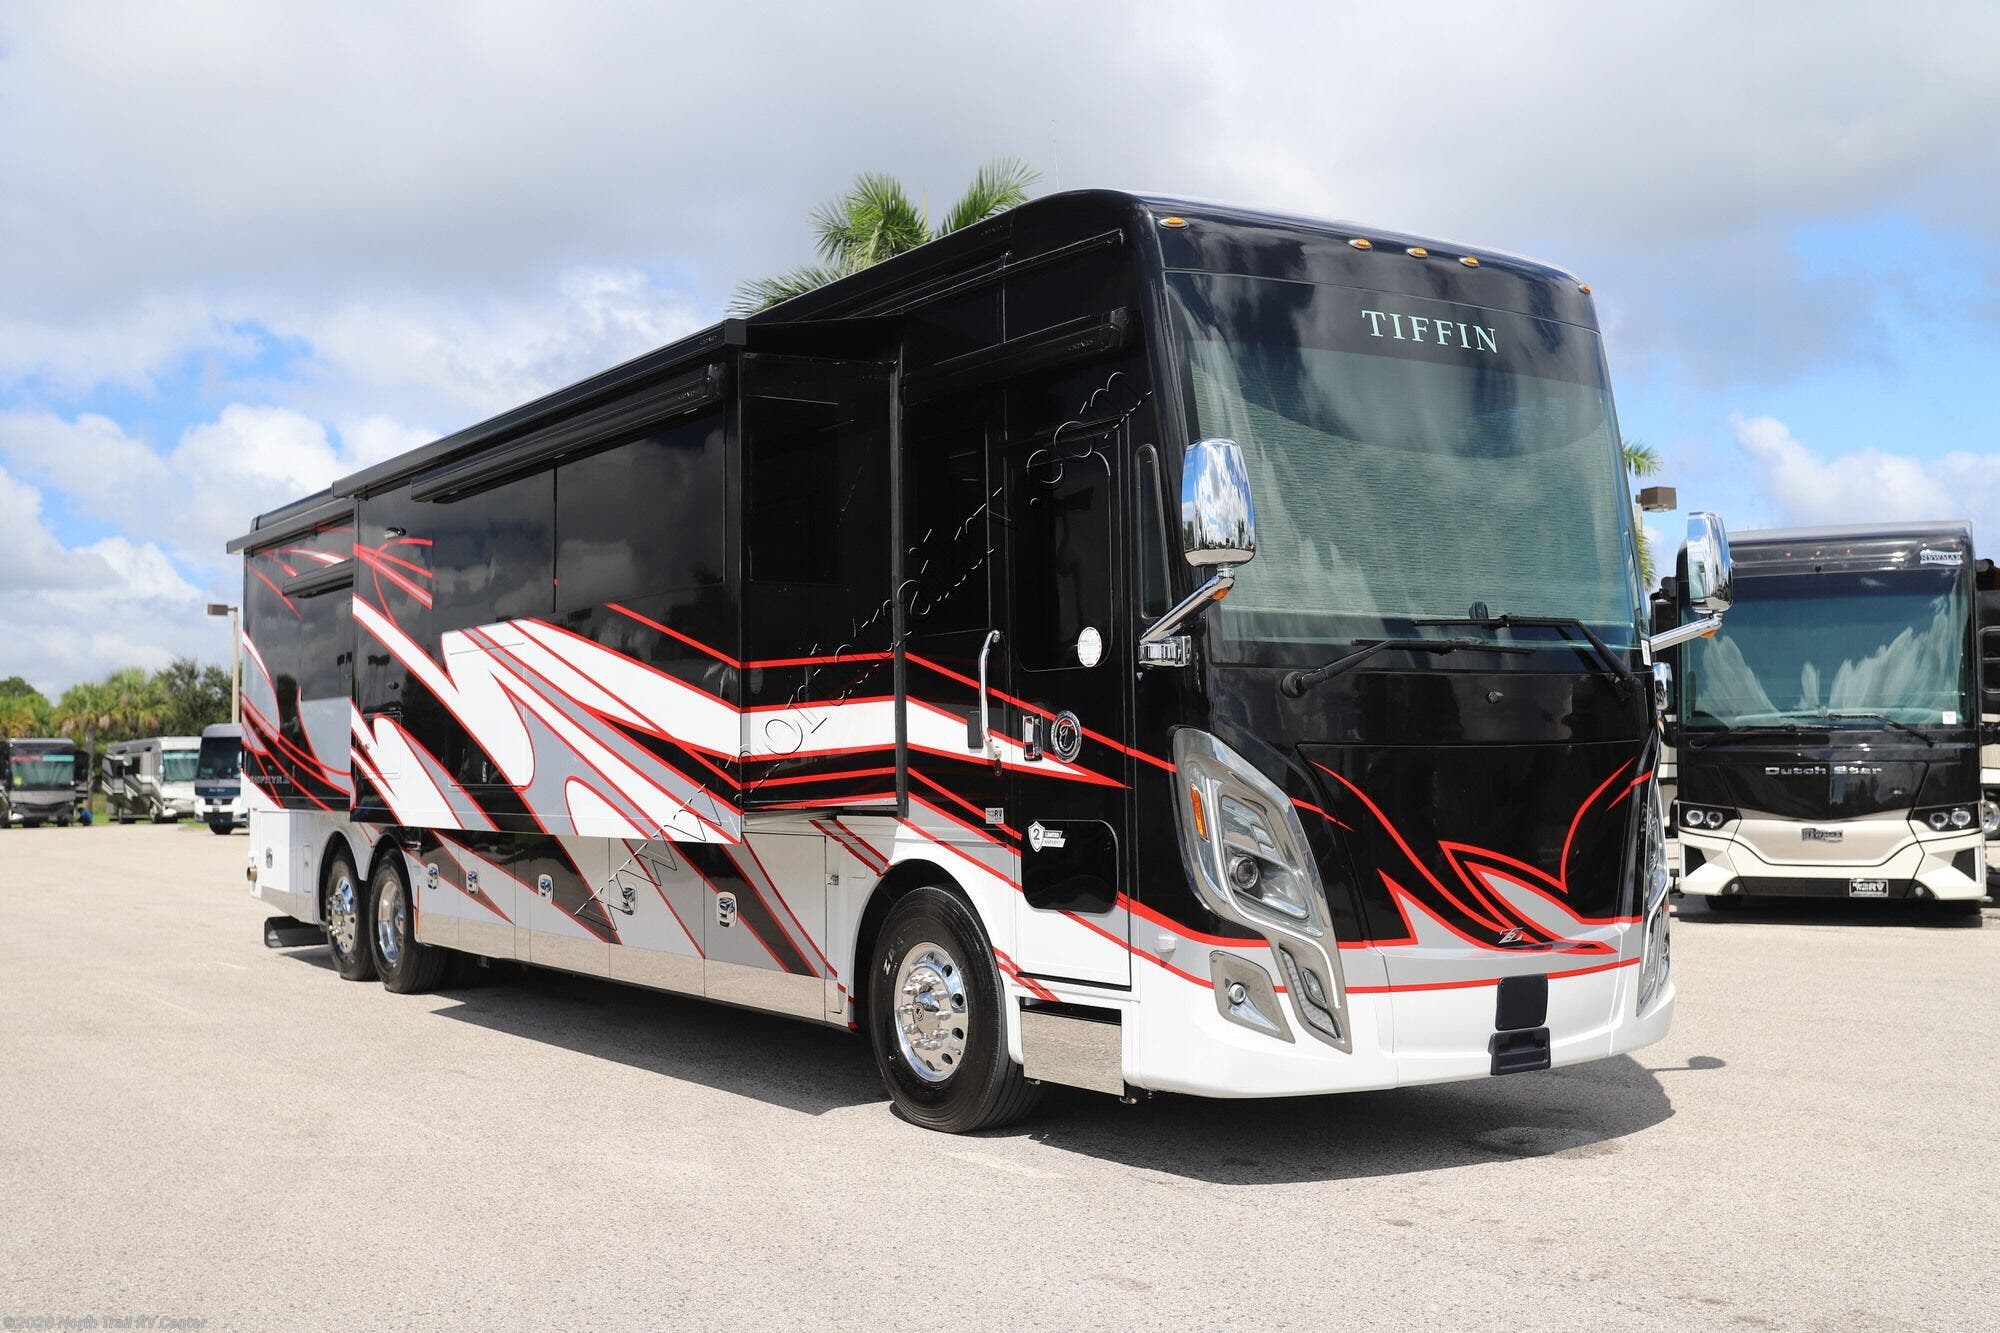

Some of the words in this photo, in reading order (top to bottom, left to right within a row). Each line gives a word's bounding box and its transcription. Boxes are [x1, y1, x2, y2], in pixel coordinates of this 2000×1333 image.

[1362, 310, 1497, 353] TIFFIN
[1765, 765, 1827, 775] Dutch
[1833, 765, 1883, 775] Star
